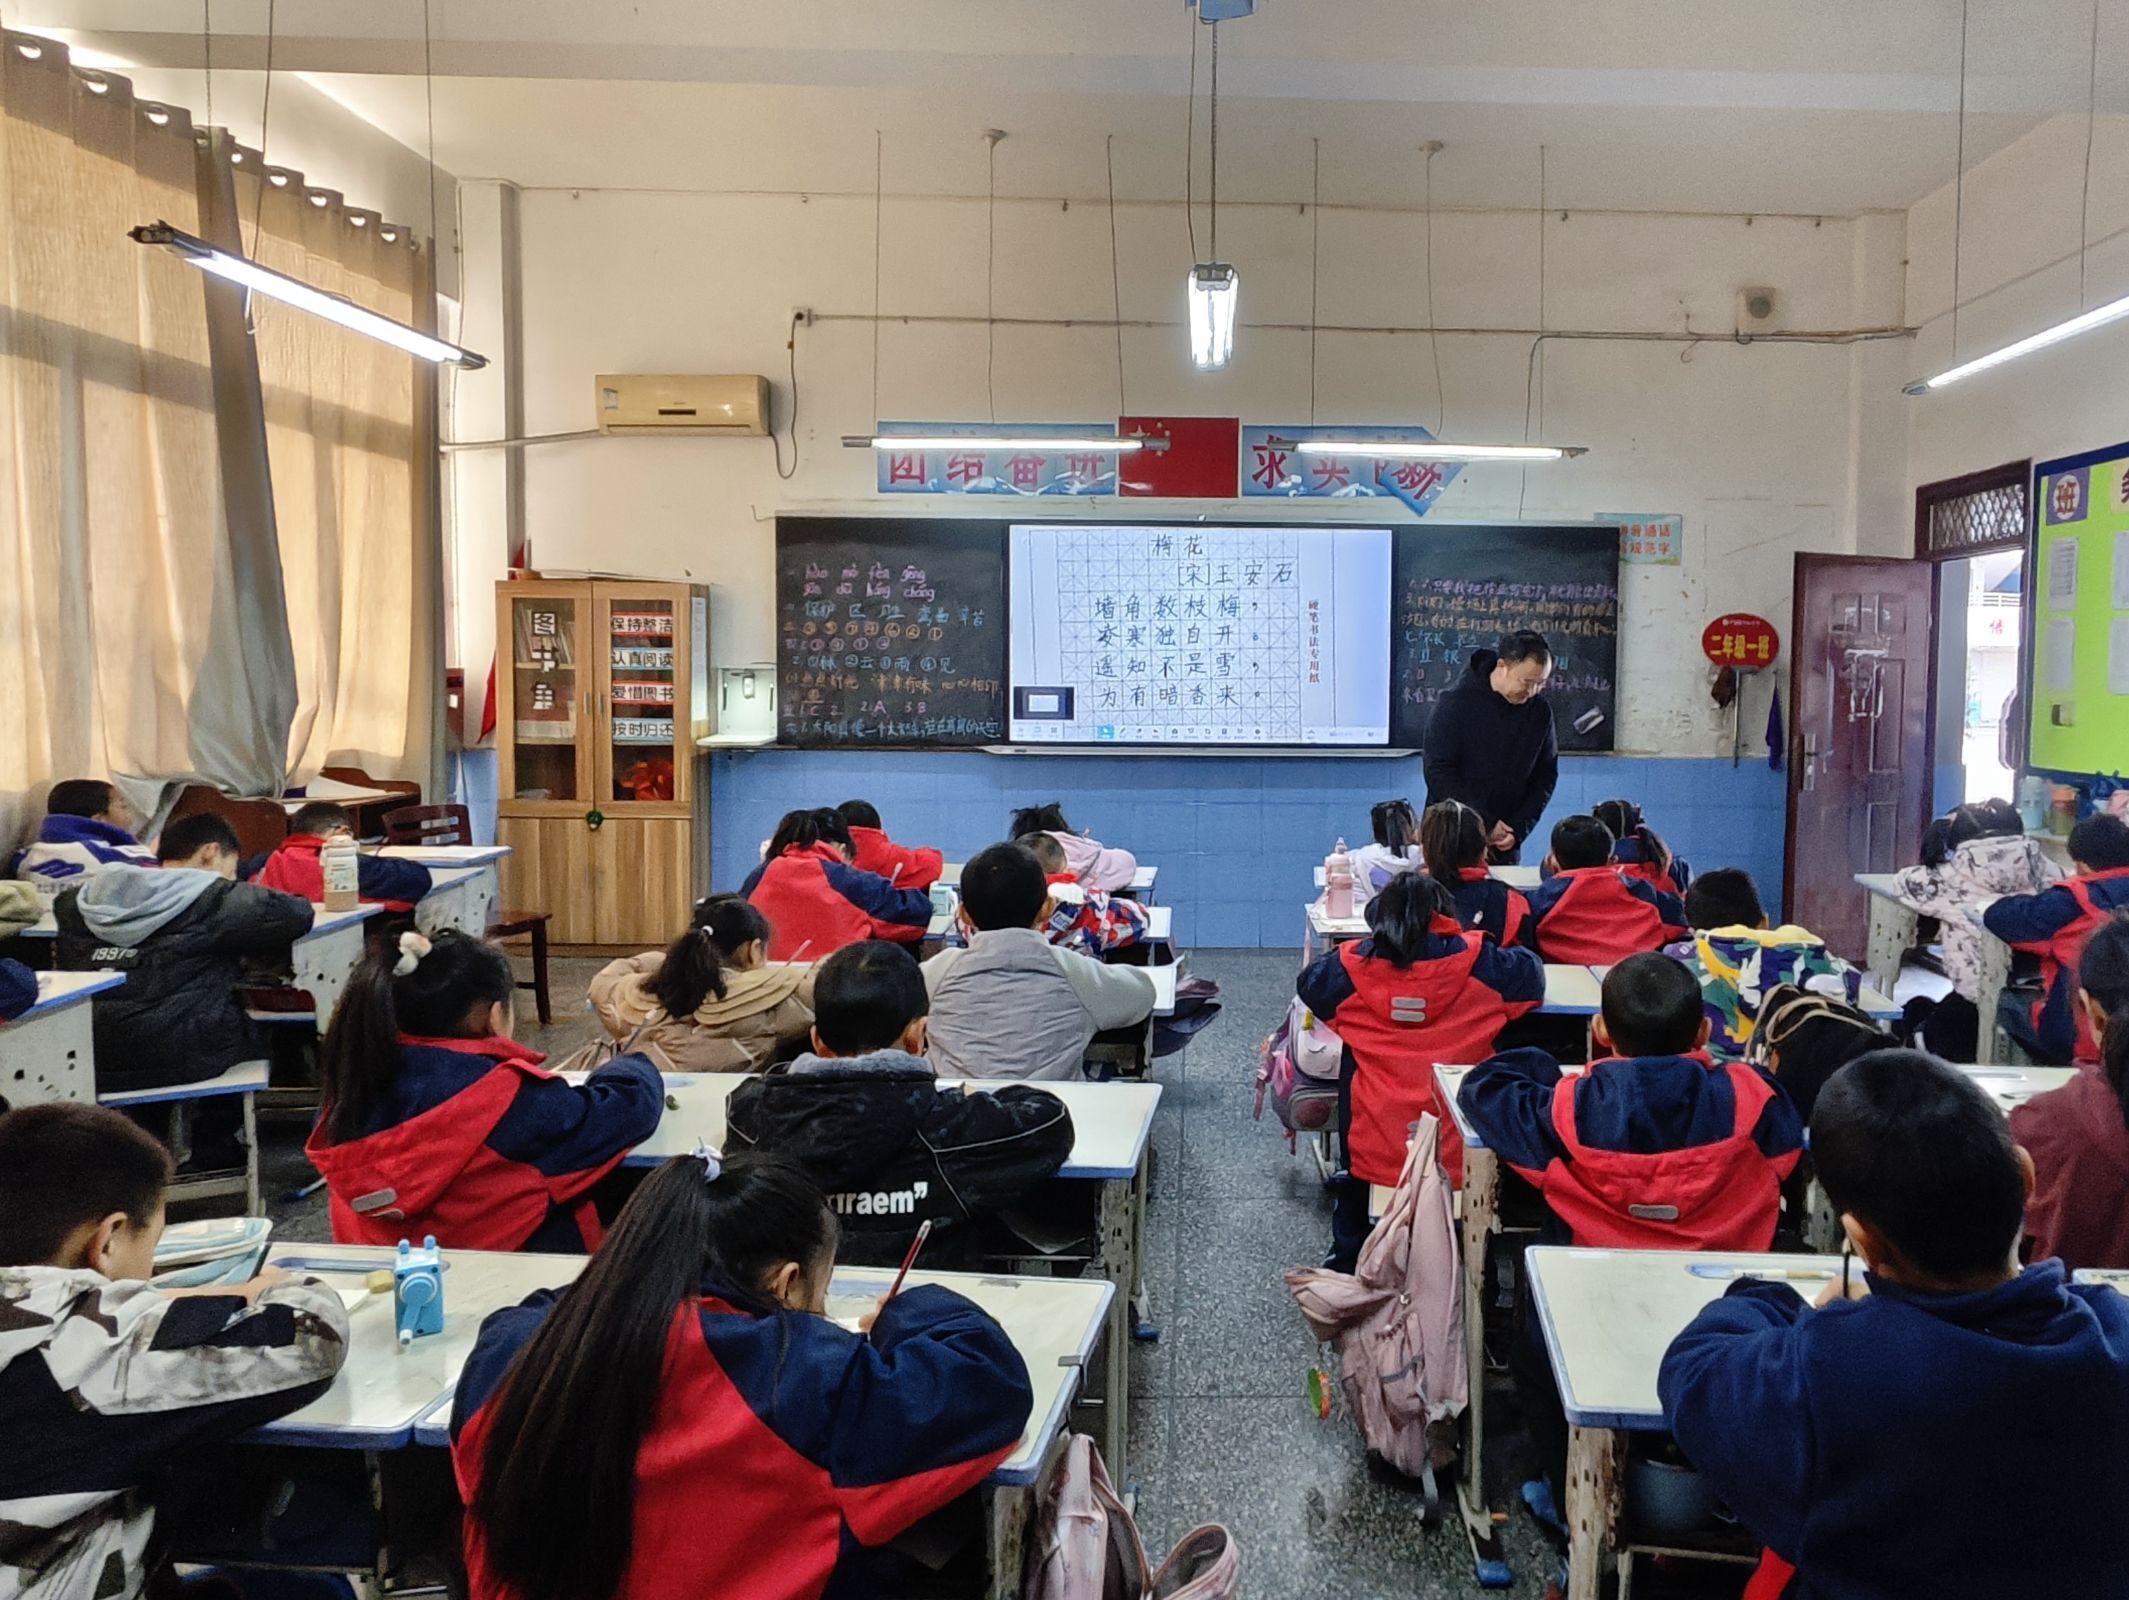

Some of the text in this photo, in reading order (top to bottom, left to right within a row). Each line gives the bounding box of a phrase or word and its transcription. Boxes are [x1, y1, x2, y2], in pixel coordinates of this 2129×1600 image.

[2055, 481, 2077, 514] 班
[1150, 533, 1203, 558] 梅花
[611, 618, 673, 633] 保持整洁
[1308, 600, 1320, 684] 硬笔书法专用纸
[611, 652, 673, 667] 认真阅读
[611, 686, 674, 702] 爱惜图书
[611, 722, 674, 738] 按时归还
